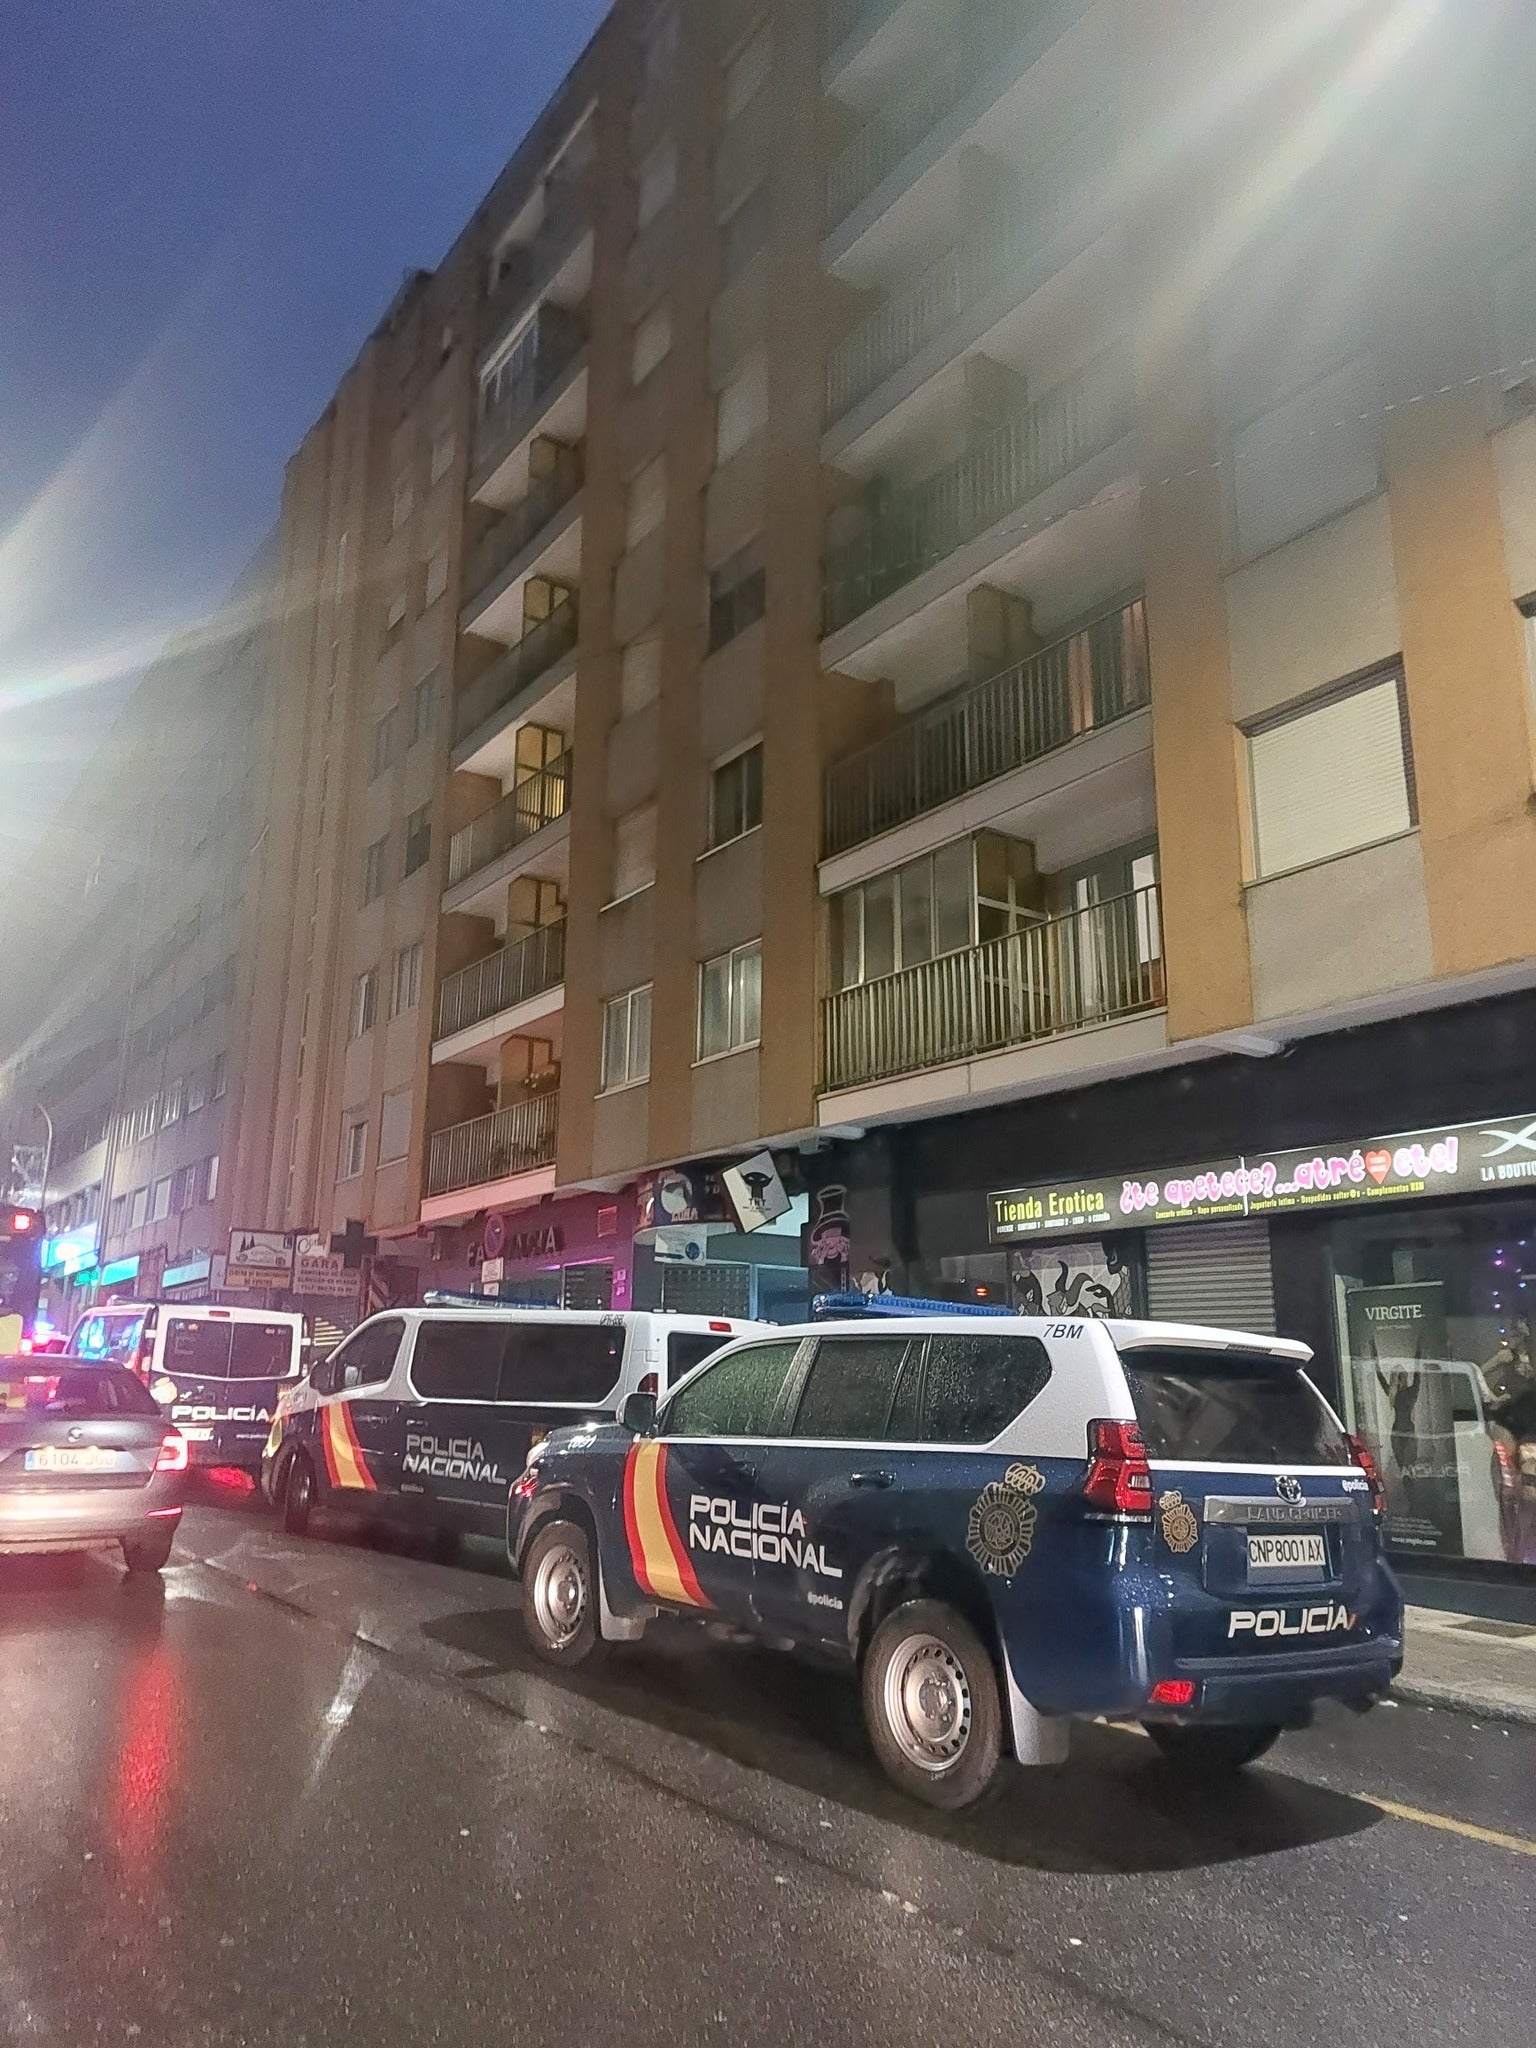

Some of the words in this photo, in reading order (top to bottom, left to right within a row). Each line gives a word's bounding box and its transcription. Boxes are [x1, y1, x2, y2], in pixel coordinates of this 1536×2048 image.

[1481, 1166, 1496, 1182] LA
[995, 1196, 1043, 1222] Tienda
[1048, 1189, 1105, 1216] Erotica
[301, 1257, 339, 1270] GARA
[1043, 1323, 1084, 1340] 7BM
[403, 1453, 507, 1485] NACIONAL
[690, 1494, 806, 1539] POLICÍA
[690, 1522, 843, 1579] NACIONAL
[1227, 1599, 1349, 1639] POLICÍA
